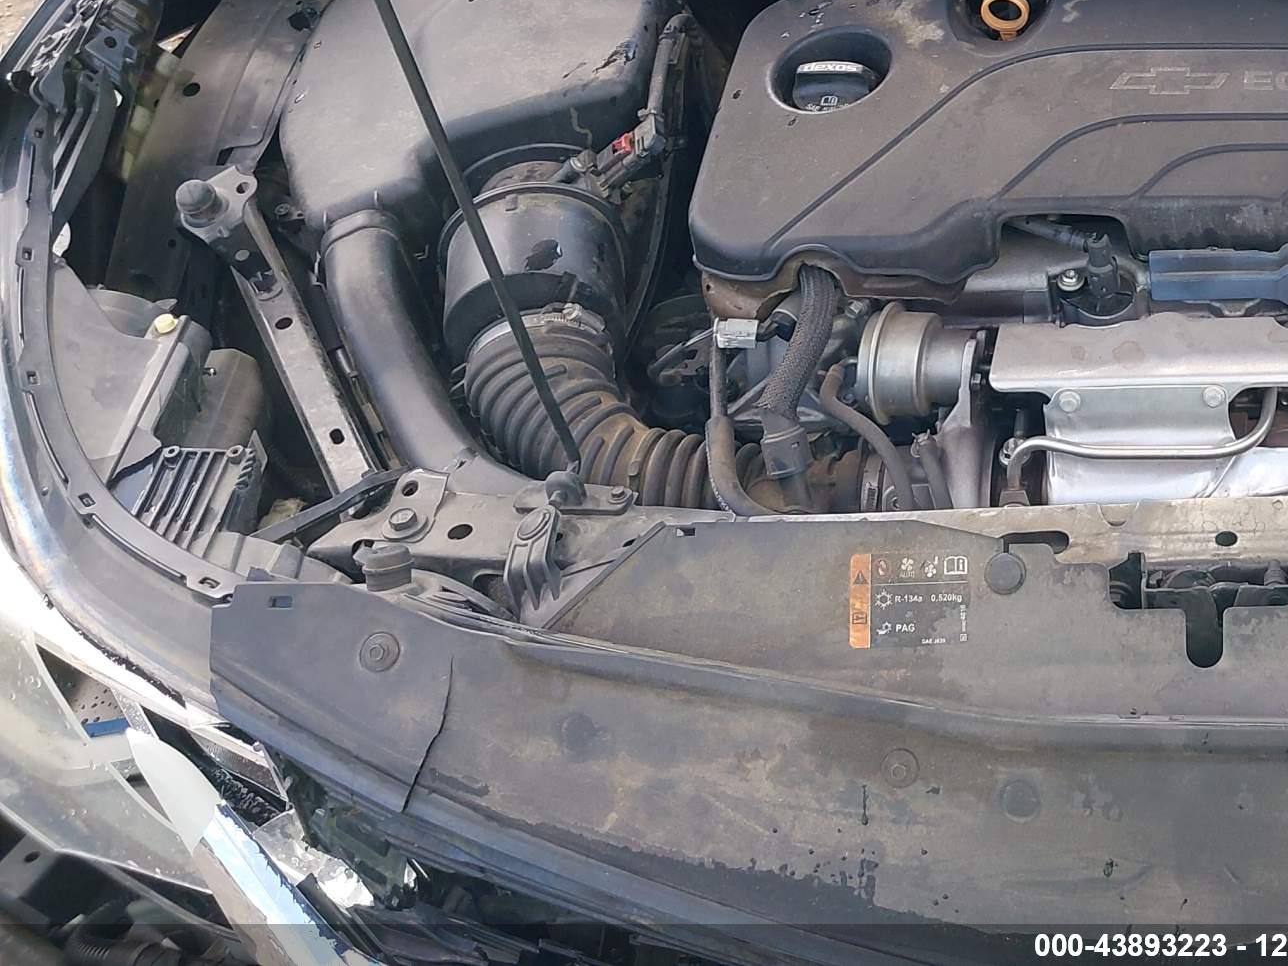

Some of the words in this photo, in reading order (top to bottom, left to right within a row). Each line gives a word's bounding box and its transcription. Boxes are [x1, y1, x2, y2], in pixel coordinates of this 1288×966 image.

[803, 62, 857, 72] dexos
[894, 594, 923, 603] R-134a
[930, 593, 963, 603] 0.520kg
[895, 623, 916, 633] PAG
